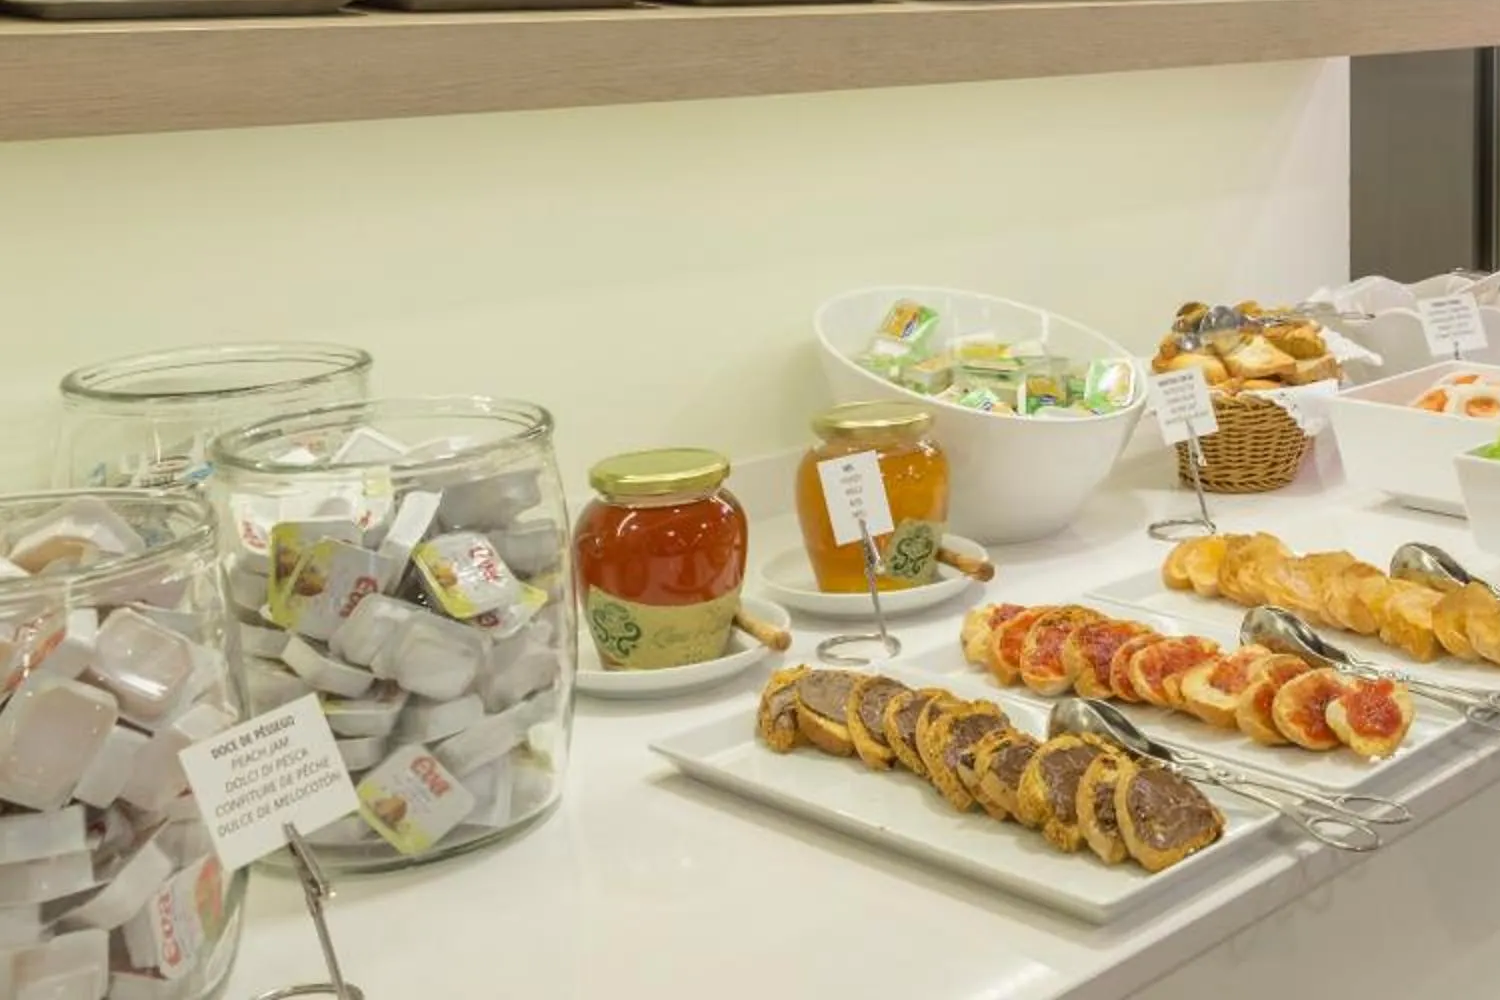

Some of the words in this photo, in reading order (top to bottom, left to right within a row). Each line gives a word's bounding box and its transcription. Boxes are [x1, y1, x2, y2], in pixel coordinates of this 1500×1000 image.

[211, 741, 237, 760] DOCE
[239, 734, 253, 747] DE
[231, 748, 269, 769] PEACH
[268, 736, 290, 757] JAM
[225, 770, 260, 793] DOLCI
[262, 764, 274, 777] DI
[276, 748, 310, 770] PESCA
[215, 782, 277, 817] CONFITURE
[279, 774, 293, 787] DE
[217, 812, 253, 838] DULCE
[256, 804, 271, 819] DE
